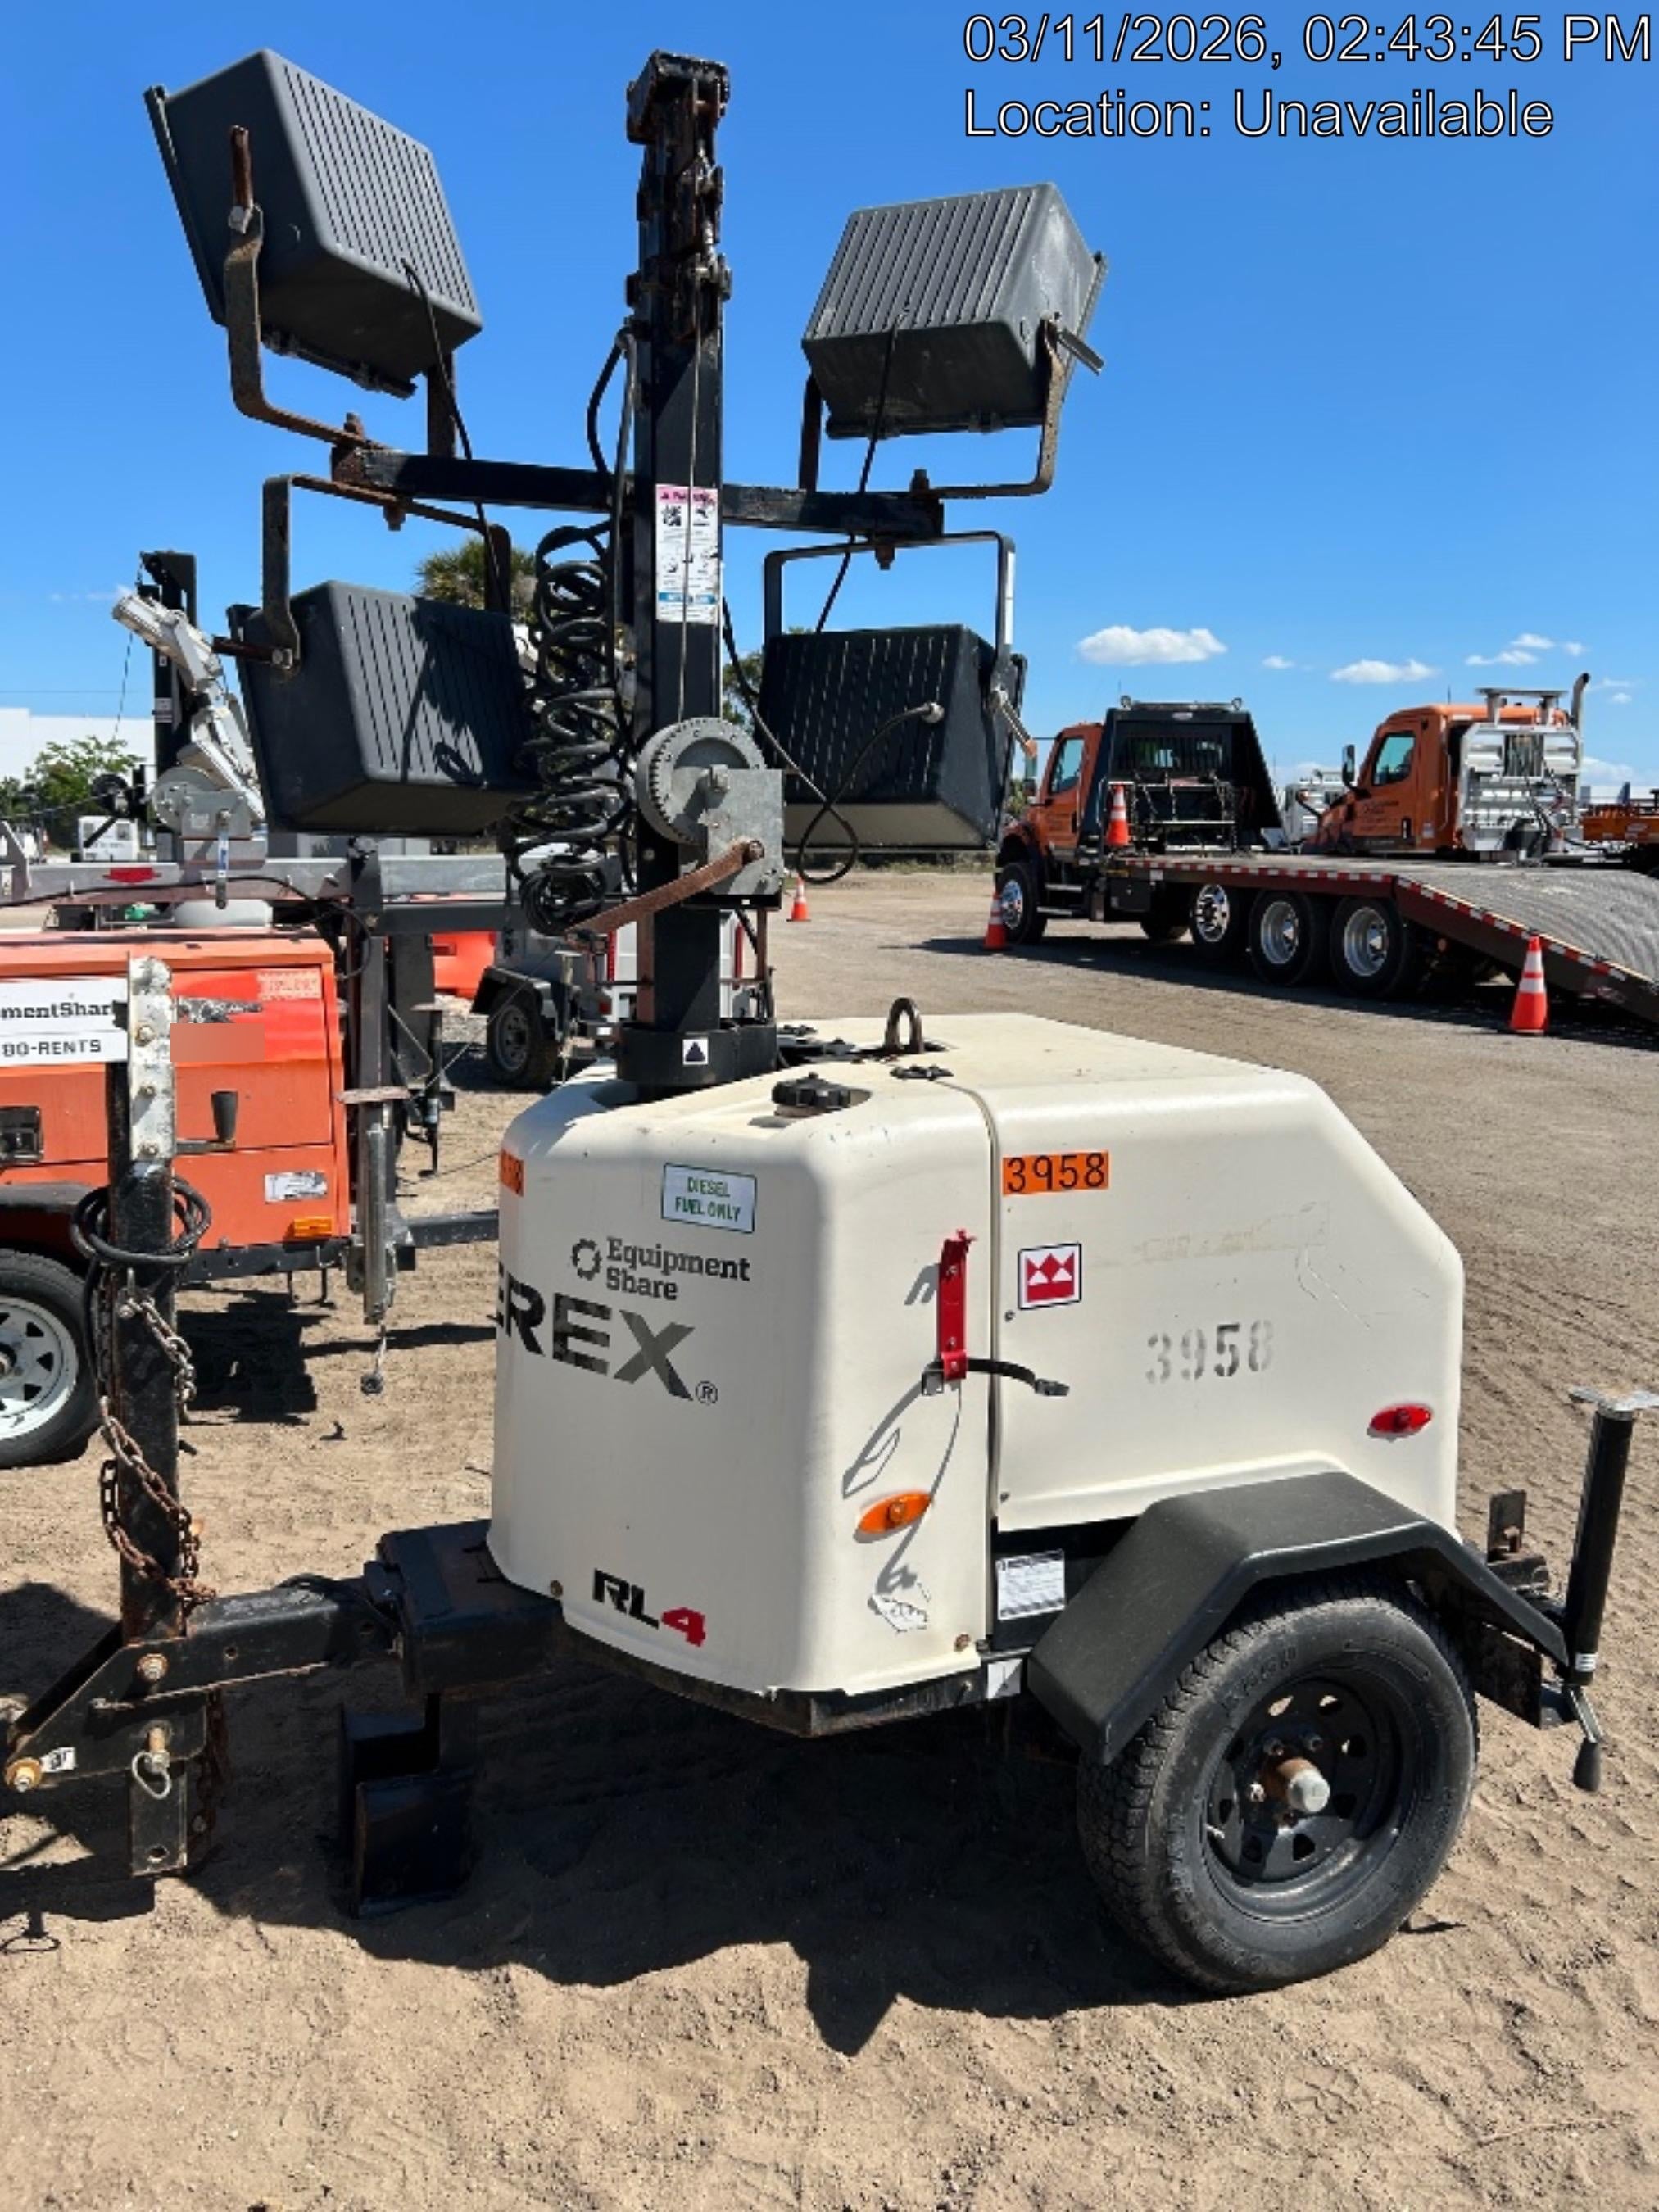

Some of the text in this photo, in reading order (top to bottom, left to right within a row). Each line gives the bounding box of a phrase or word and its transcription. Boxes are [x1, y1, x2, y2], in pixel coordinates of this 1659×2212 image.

[687, 1176, 731, 1198] DIESEL
[1006, 1152, 1105, 1193] 3958
[674, 1196, 741, 1222] FUEL ONLY
[606, 1236, 751, 1281] Equipment
[606, 1266, 678, 1301] Share
[1145, 1320, 1274, 1385] 3958
